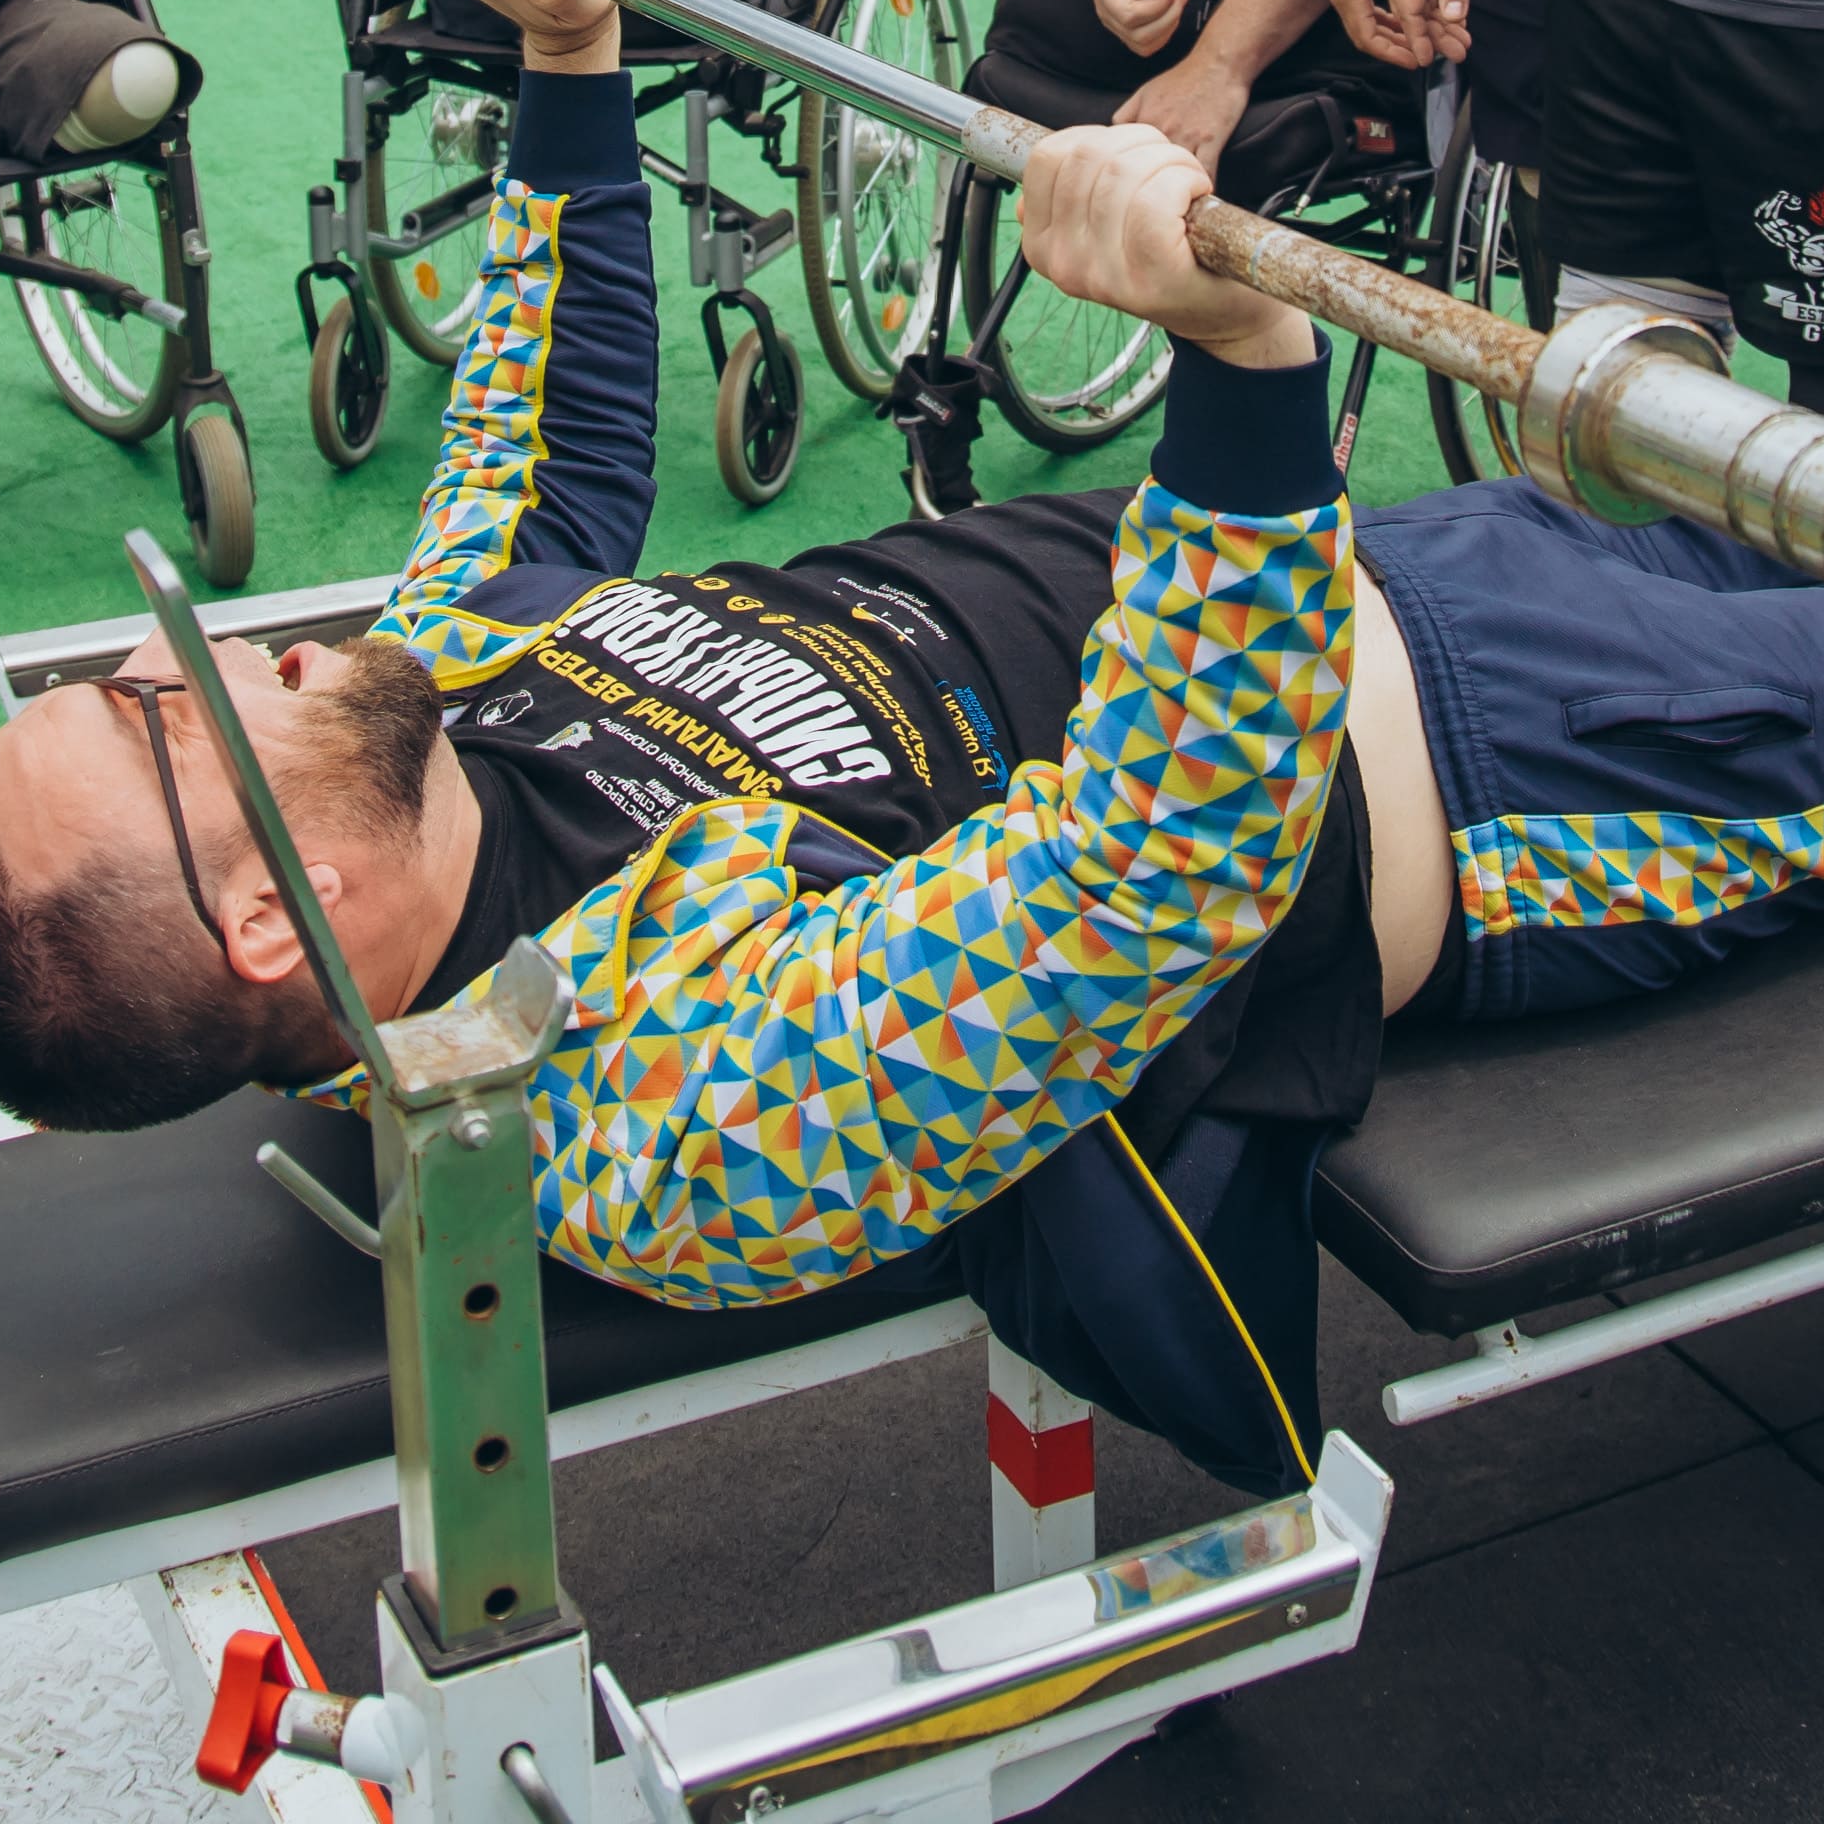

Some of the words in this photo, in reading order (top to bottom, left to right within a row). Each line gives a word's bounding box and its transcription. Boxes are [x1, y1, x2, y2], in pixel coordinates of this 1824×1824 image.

[847, 639, 892, 677] СЕРЕД
[962, 685, 997, 737] ЛЕОНОВА
[596, 716, 660, 756] СПОРТИВНІ
[971, 757, 997, 778] Я
[584, 768, 655, 832] МІНІСТЕРСТВО
